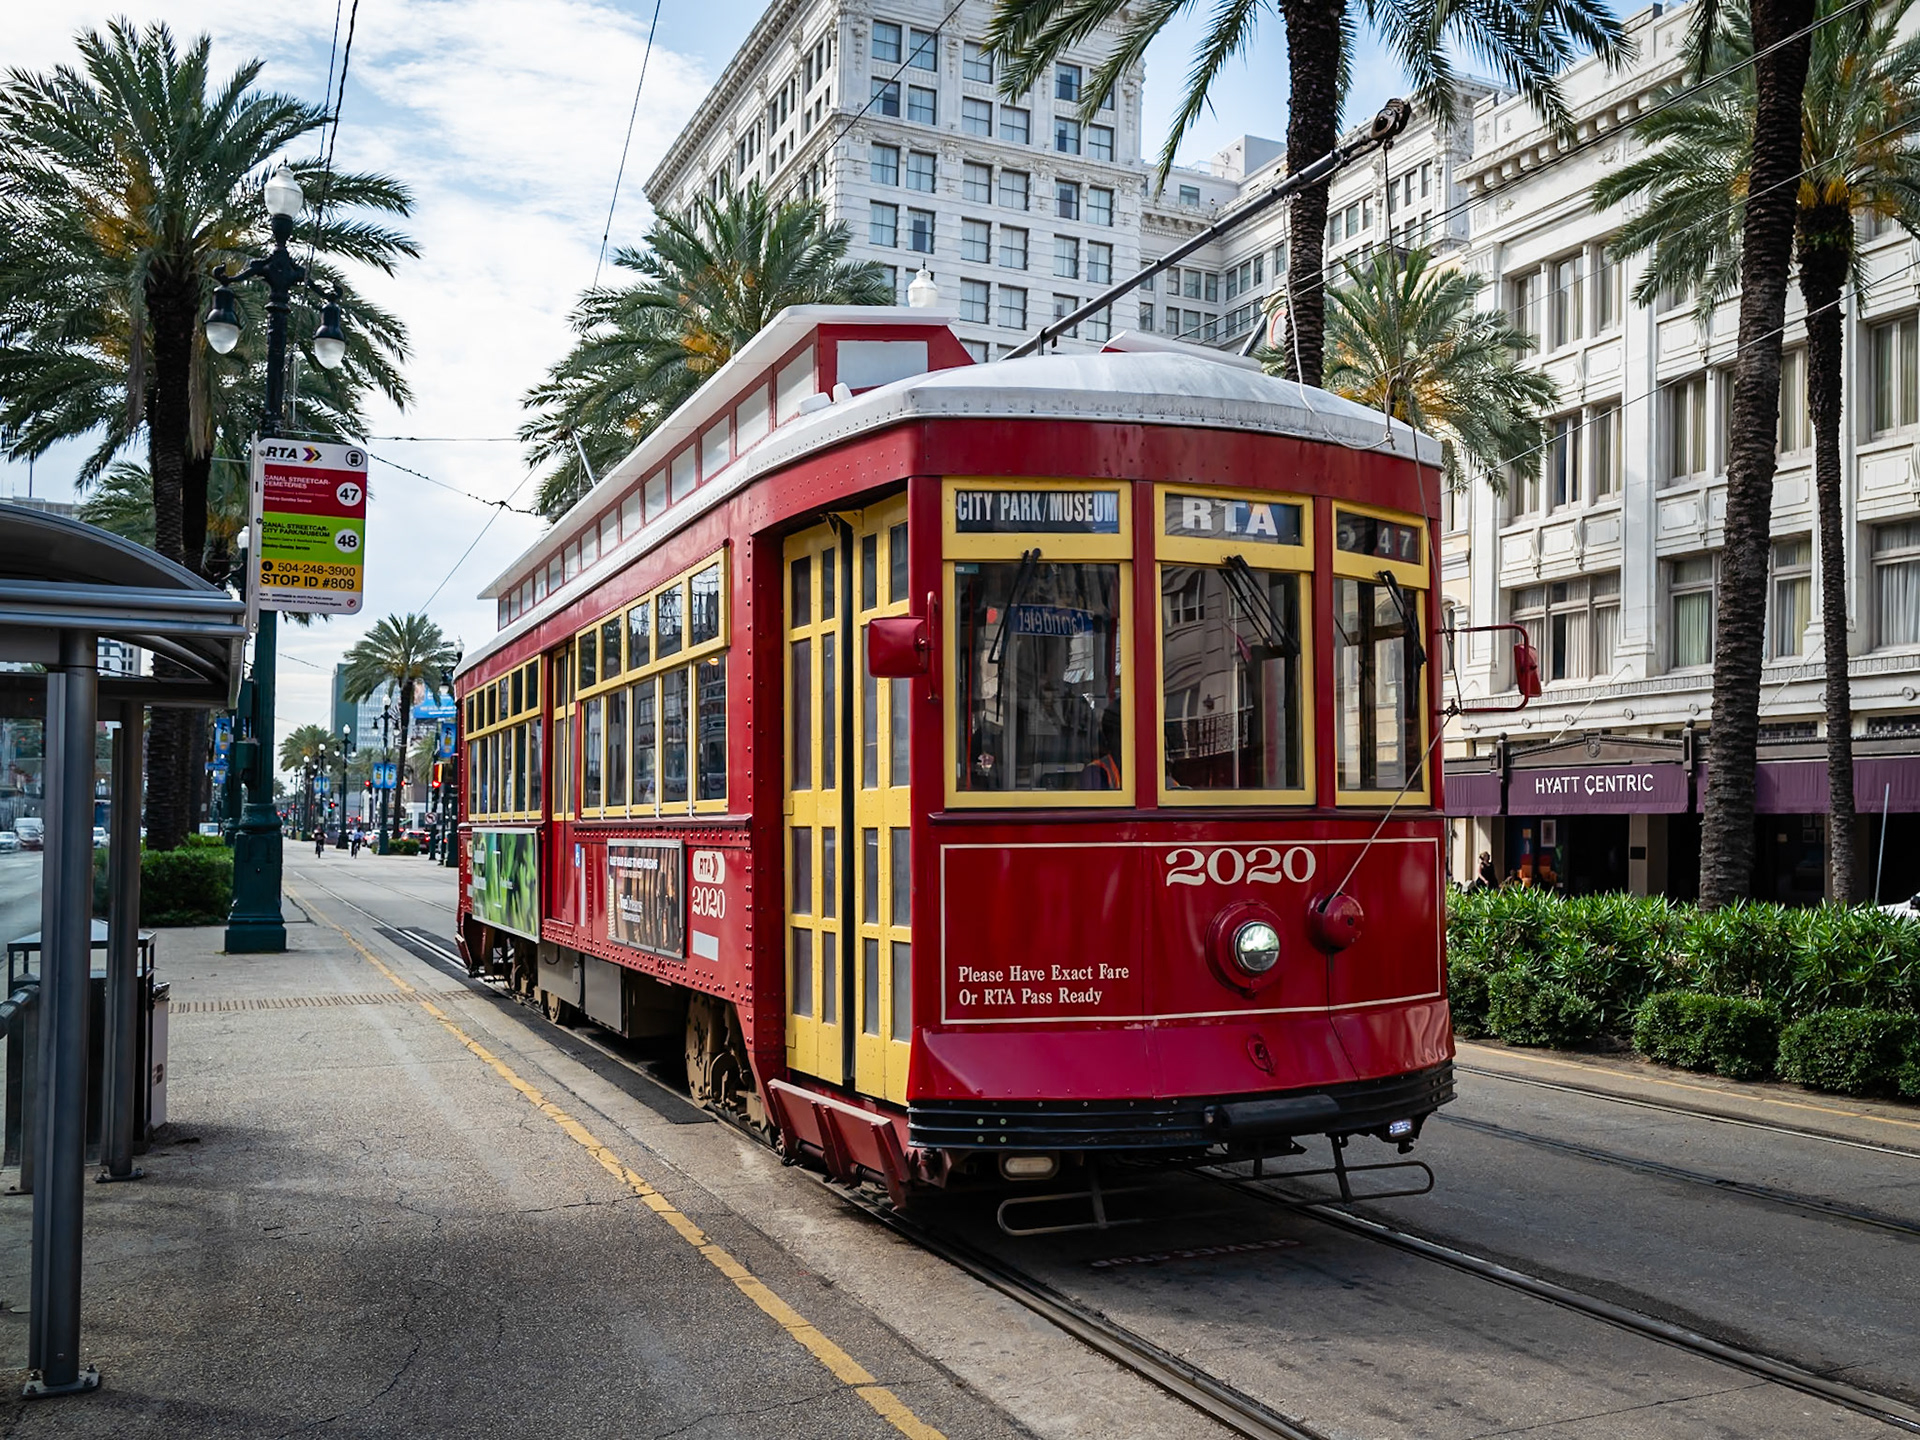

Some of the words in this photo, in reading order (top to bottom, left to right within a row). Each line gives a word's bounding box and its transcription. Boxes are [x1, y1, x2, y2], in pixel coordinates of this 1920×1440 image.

[266, 446, 298, 459] RTA
[339, 488, 359, 501] 47
[957, 491, 993, 522] CITY
[1000, 491, 1118, 524] PARK/MUSEUM
[1182, 497, 1278, 536] RTA
[337, 534, 358, 548] 48
[1379, 527, 1411, 557] 47
[278, 562, 356, 577] 504-248-3900
[261, 573, 300, 587] STOP
[304, 576, 318, 588] ID
[322, 578, 355, 590] #809
[1535, 776, 1580, 795] HYATT
[1584, 773, 1654, 796] CENTRIC
[699, 857, 711, 875] RTA
[1165, 847, 1317, 887] 2020
[691, 885, 726, 920] 2020
[958, 966, 1004, 984] Please
[1009, 965, 1046, 982] Have
[1051, 964, 1093, 982] Exact
[1098, 963, 1130, 980] Fare
[958, 988, 979, 1006] Or
[983, 988, 1016, 1006] RTA
[1021, 988, 1054, 1004] Pass
[1058, 987, 1103, 1005] Ready
